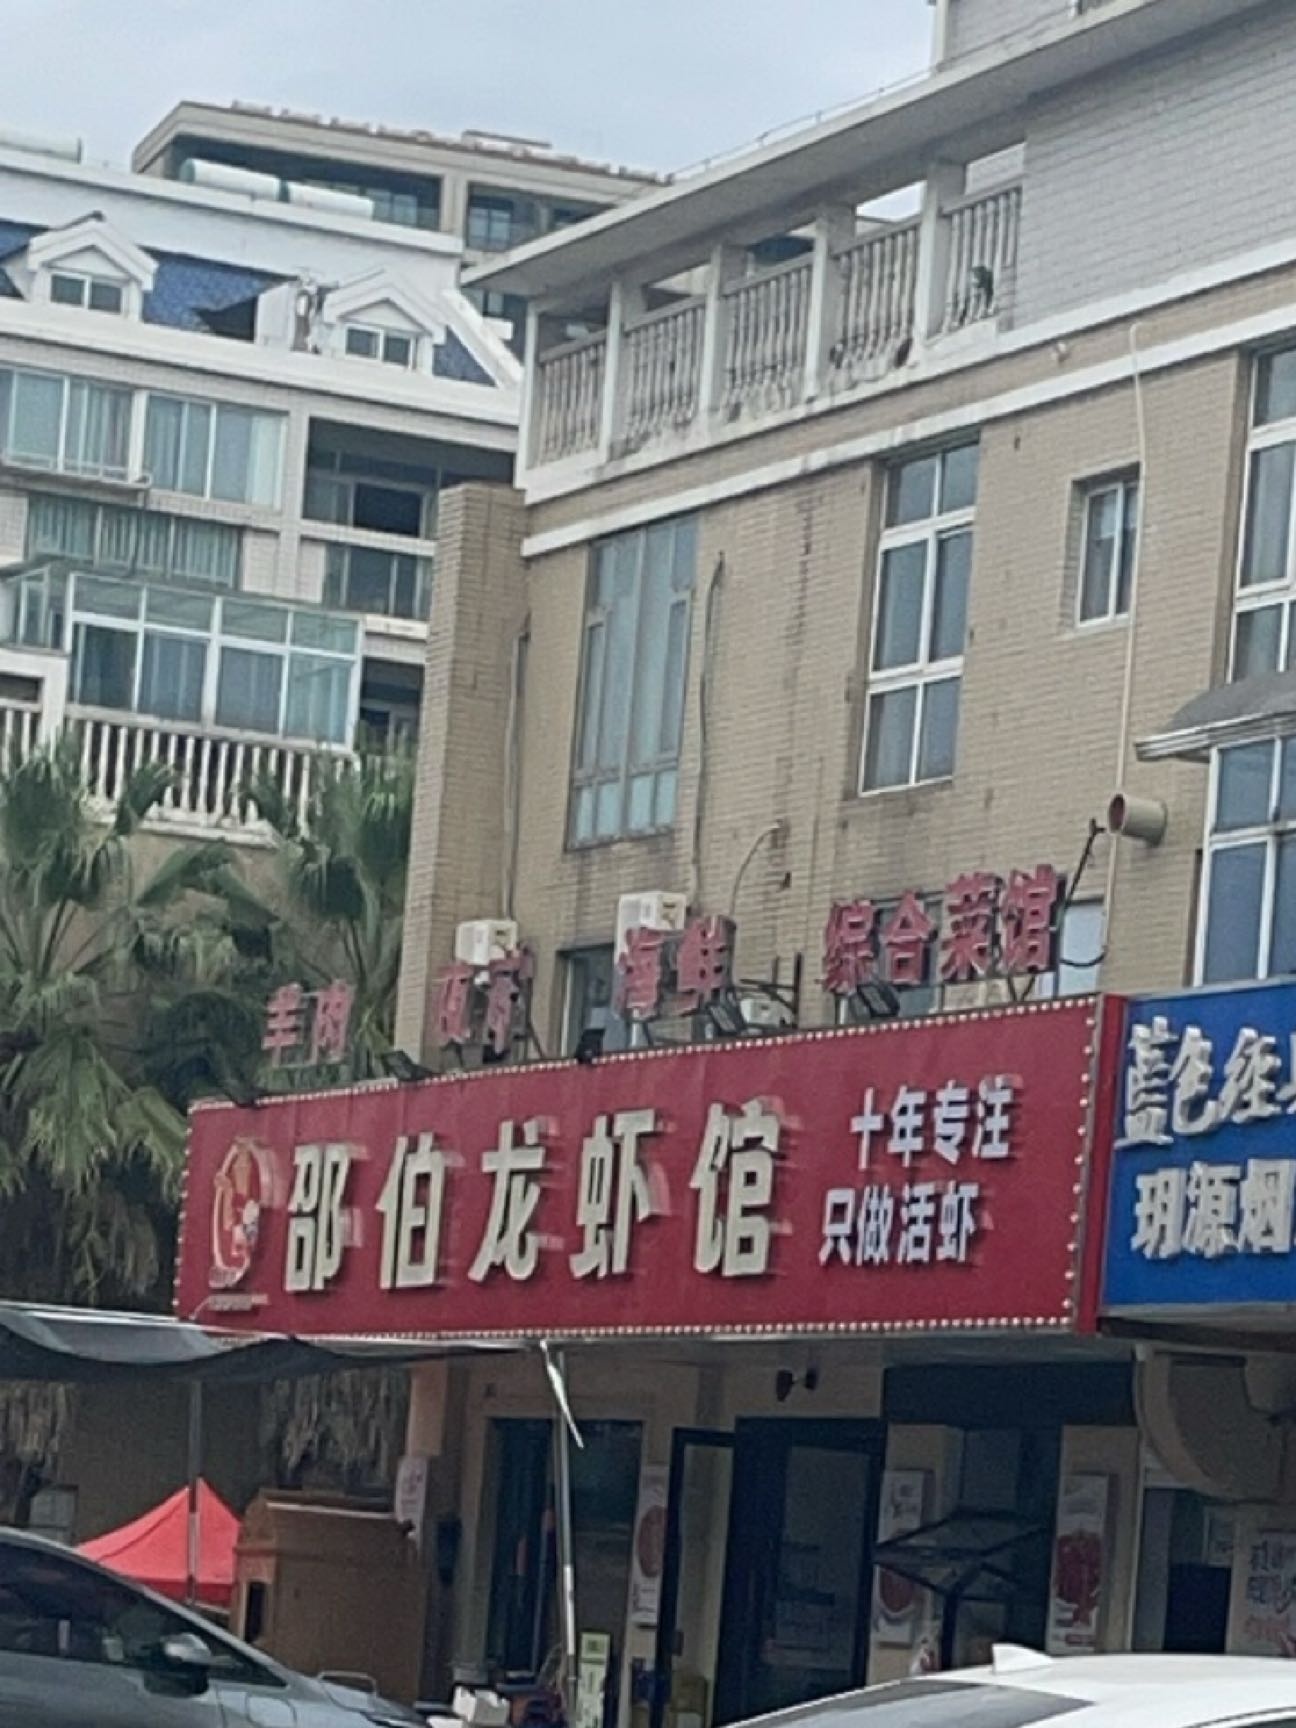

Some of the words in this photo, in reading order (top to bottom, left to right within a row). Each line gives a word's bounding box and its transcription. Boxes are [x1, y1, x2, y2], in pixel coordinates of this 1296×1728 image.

[821, 865, 1060, 994] 综合菜馆
[850, 1076, 1015, 1171] 十年专注
[285, 1100, 781, 1292] 邵伯龙虾馆
[819, 1181, 981, 1266] 只做活虾
